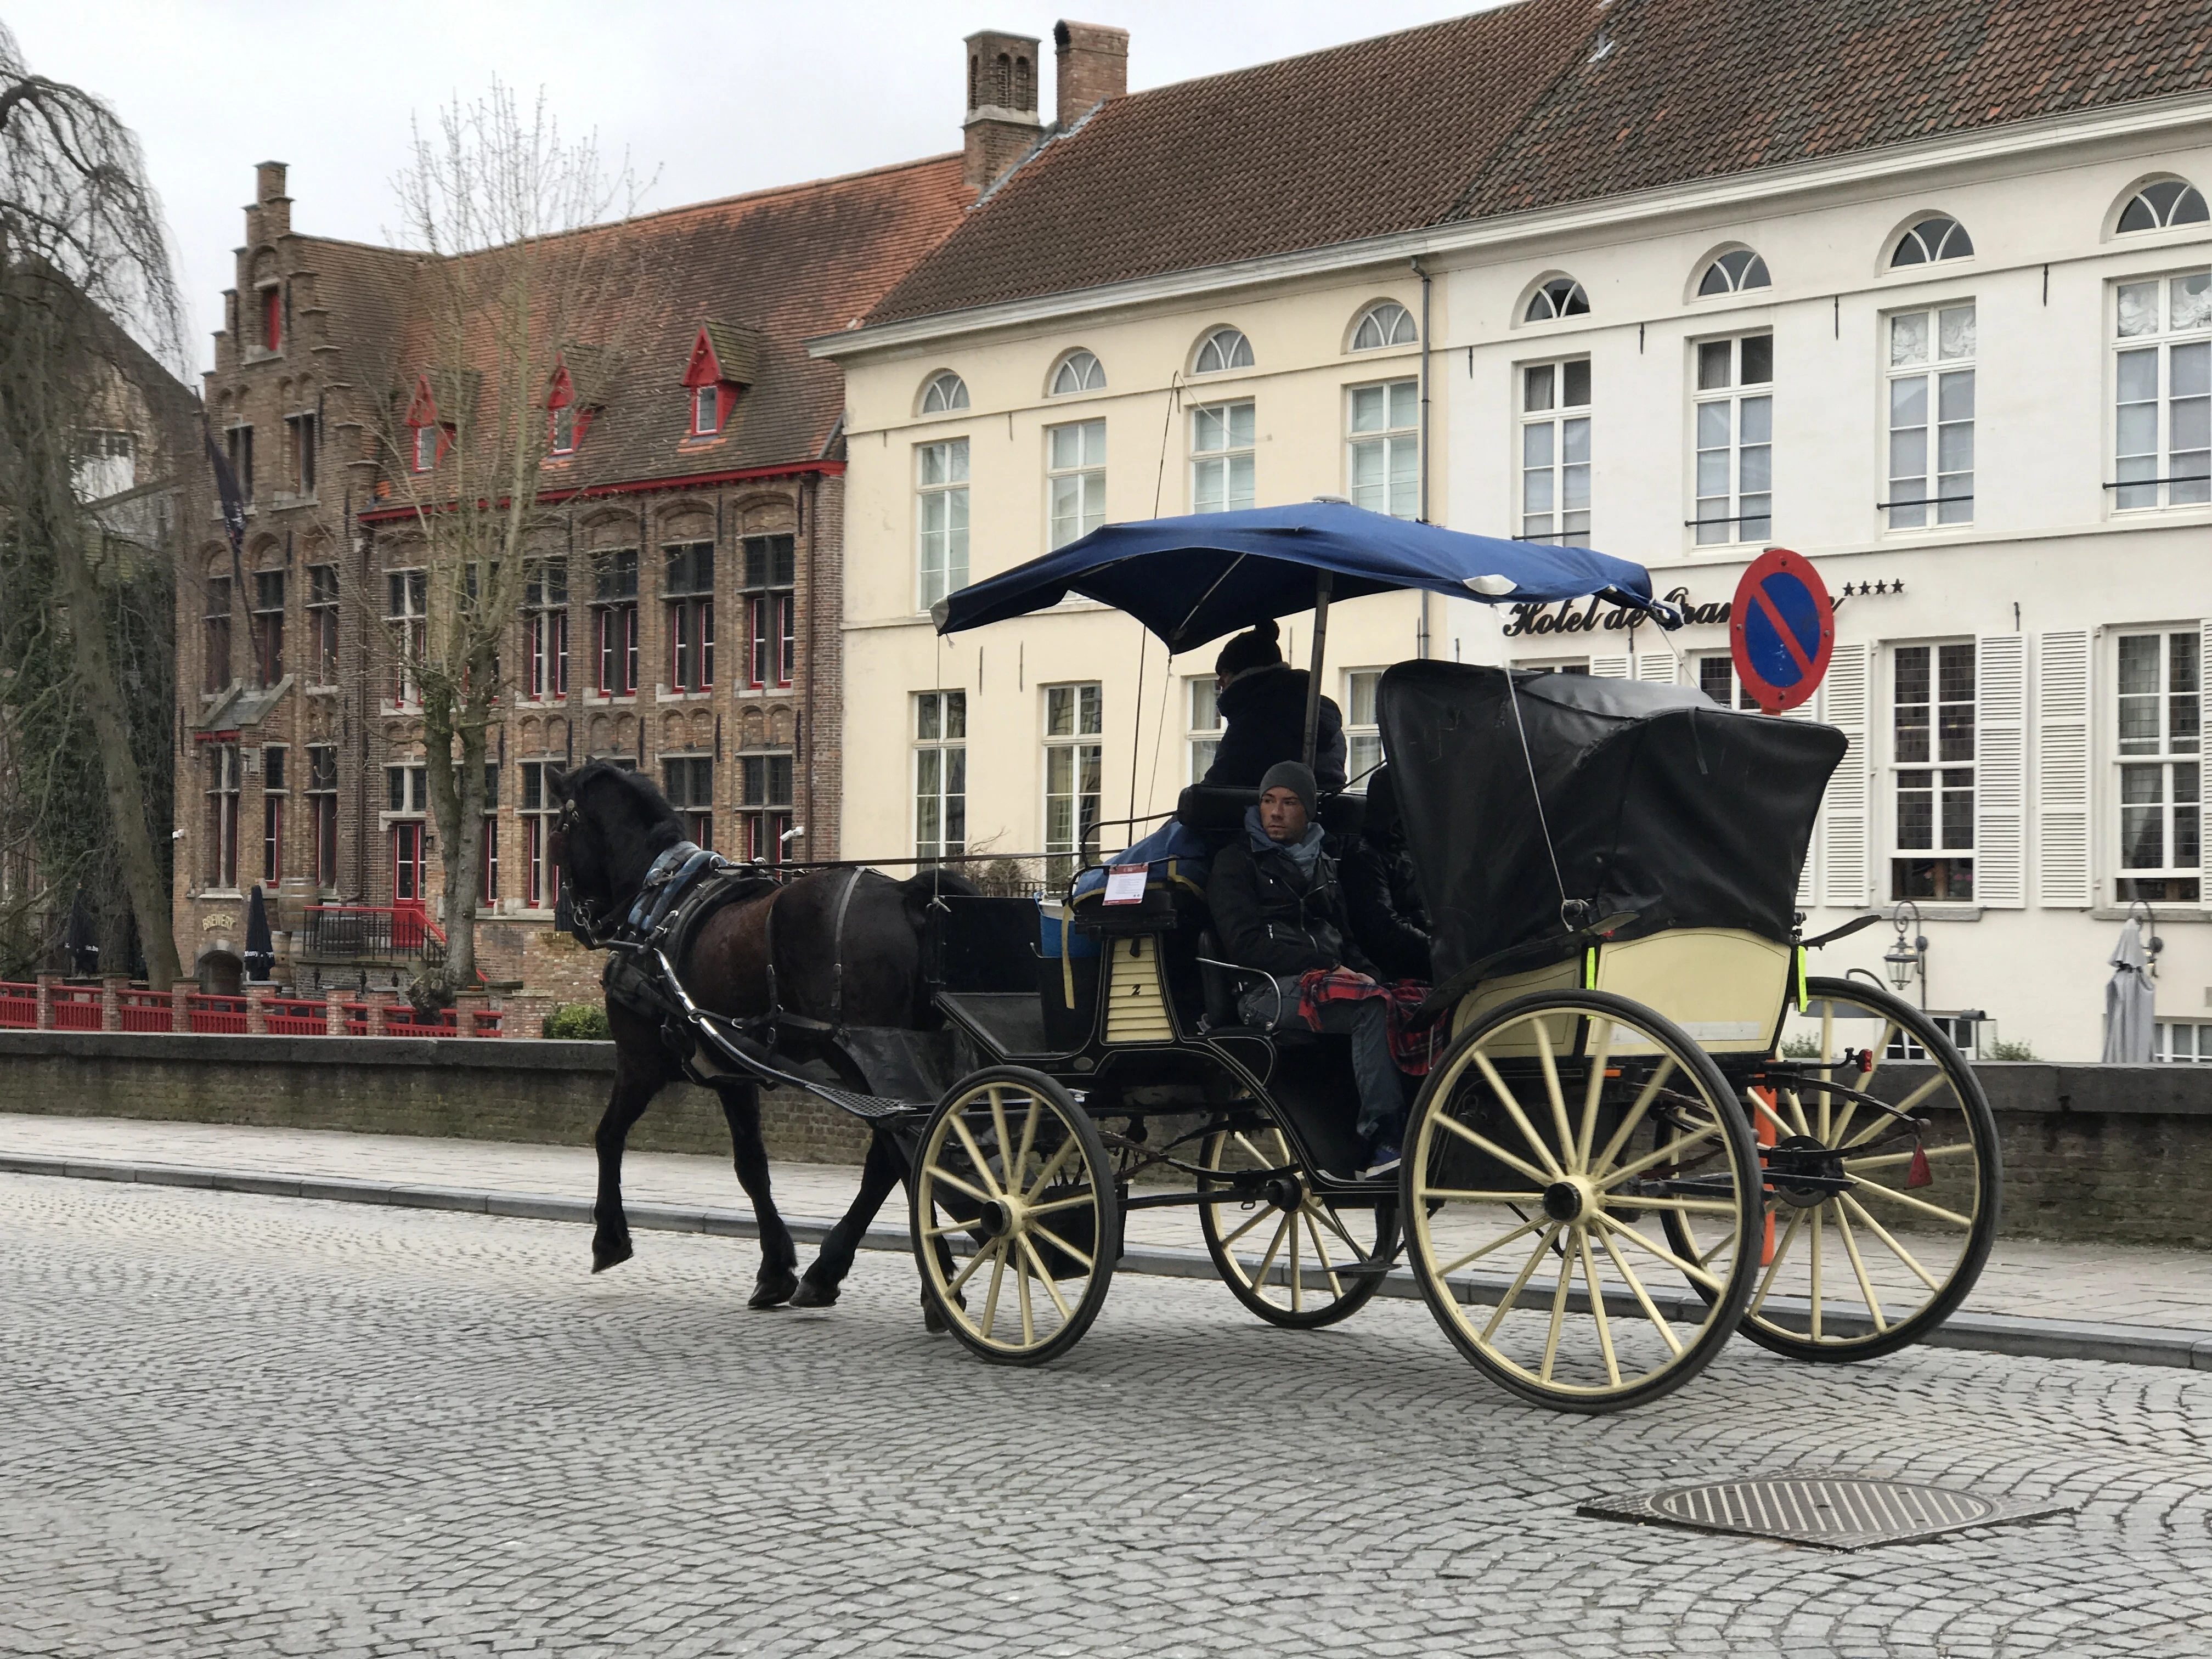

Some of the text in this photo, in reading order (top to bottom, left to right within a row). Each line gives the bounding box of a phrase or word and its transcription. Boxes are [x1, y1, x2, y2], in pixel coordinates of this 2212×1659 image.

[1503, 596, 1649, 637] Hotel de
[202, 913, 236, 931] BREWERY
[1131, 984, 1141, 996] 2
